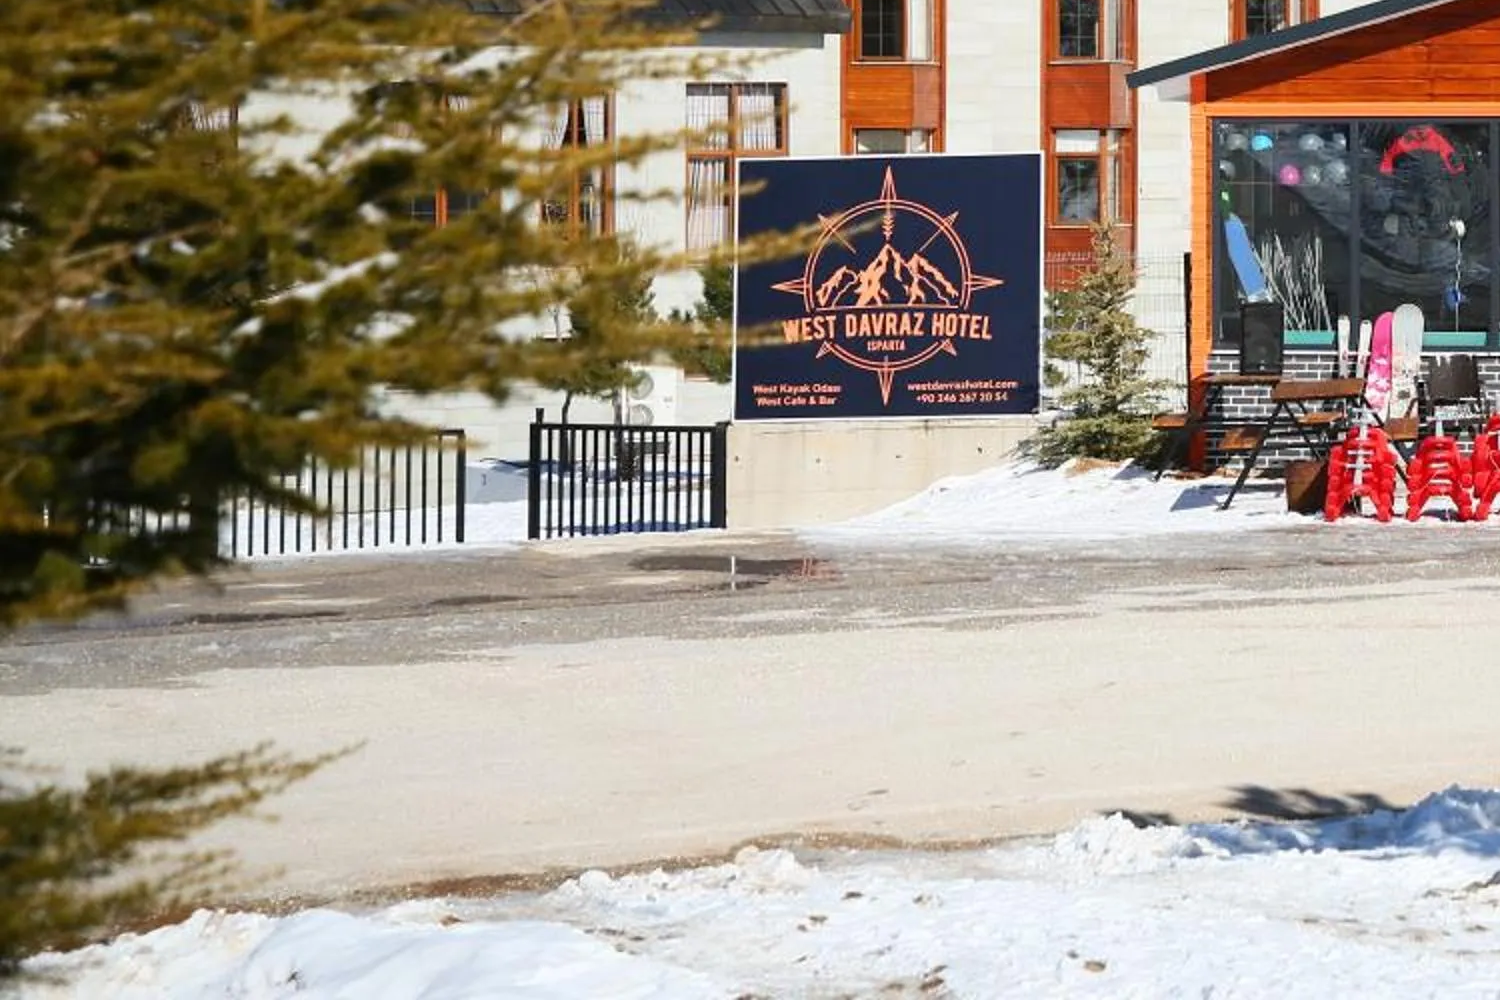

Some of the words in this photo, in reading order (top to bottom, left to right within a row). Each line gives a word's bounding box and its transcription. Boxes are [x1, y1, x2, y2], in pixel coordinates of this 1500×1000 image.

[782, 315, 836, 344] WEST
[845, 312, 924, 338] DAVRAZ
[931, 313, 992, 340] HOTEL
[867, 340, 905, 351] ISPARTA
[780, 383, 810, 395] Kayak
[809, 396, 817, 405] &
